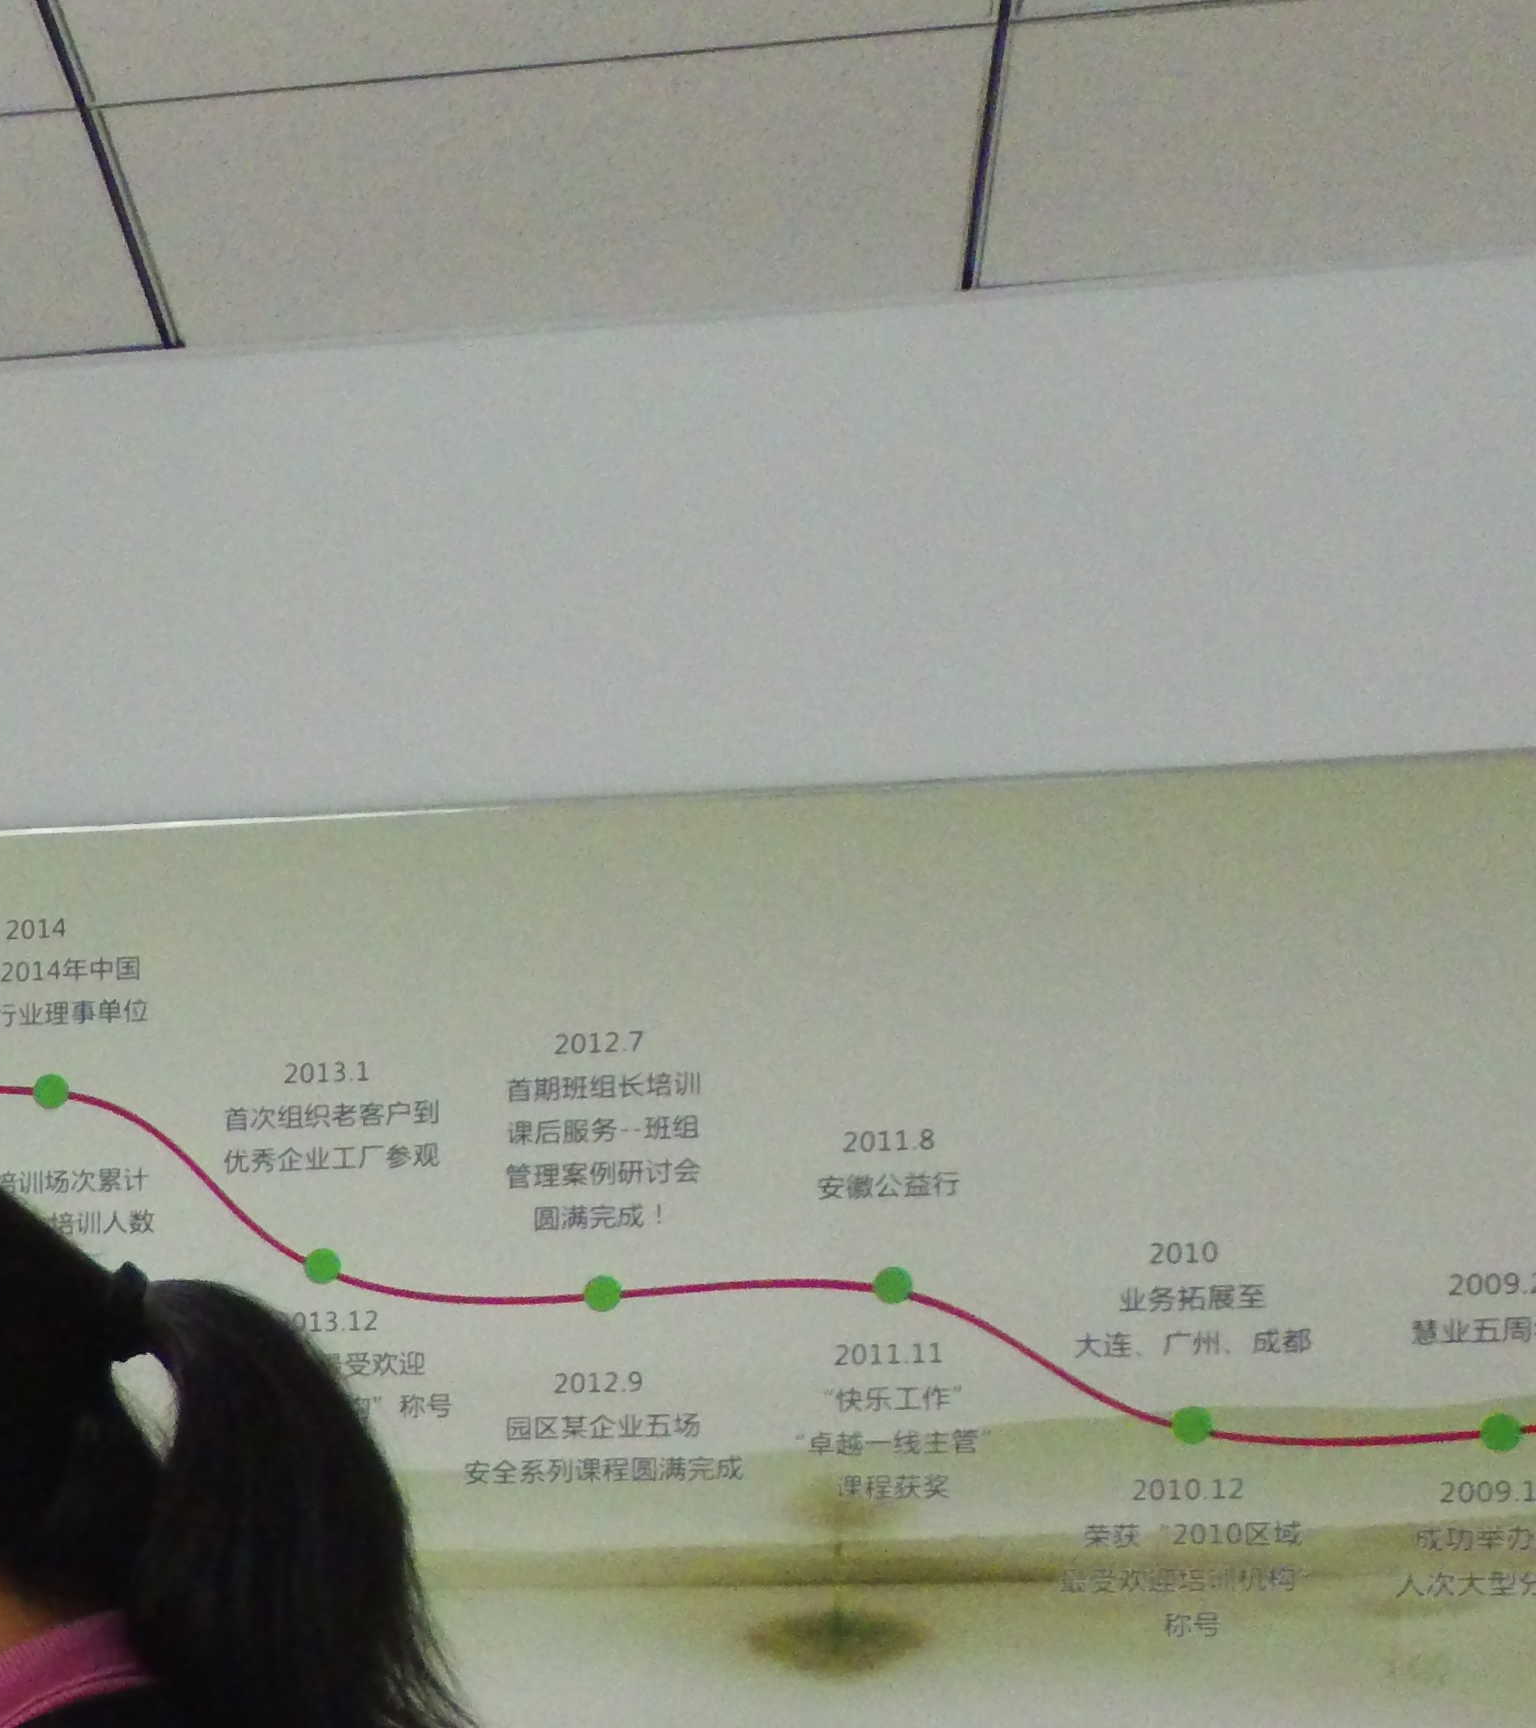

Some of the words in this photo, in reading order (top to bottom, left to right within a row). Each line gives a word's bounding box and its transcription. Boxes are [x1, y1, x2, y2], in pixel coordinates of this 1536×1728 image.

[5, 918, 66, 940] 2014
[553, 1030, 645, 1055] 2012.7
[283, 1060, 369, 1084] 2013.1
[507, 1070, 702, 1103] 首期班组长培训
[225, 1098, 441, 1132] 首次组织老客户到
[842, 1128, 936, 1153] 2011.8
[224, 1142, 441, 1175] 优秀企业工厂参观
[506, 1157, 701, 1190] 管理案例研讨会
[817, 1171, 961, 1200] 安徽公益行
[1148, 1240, 1219, 1265] 2010
[1119, 1283, 1267, 1313] 业务拓展至
[290, 1309, 378, 1332] 013.12
[1412, 1315, 1536, 1346] 慧业五周
[834, 1342, 943, 1366] 2011.11
[553, 1371, 644, 1394] 2012.9
[506, 1412, 702, 1441] 园区某企业五场
[464, 1455, 745, 1485] 安全系列课程圆满完成
[838, 1473, 951, 1500] 课程获奖
[1132, 1477, 1245, 1501] 2010.12
[1164, 1611, 1221, 1638] 称号
